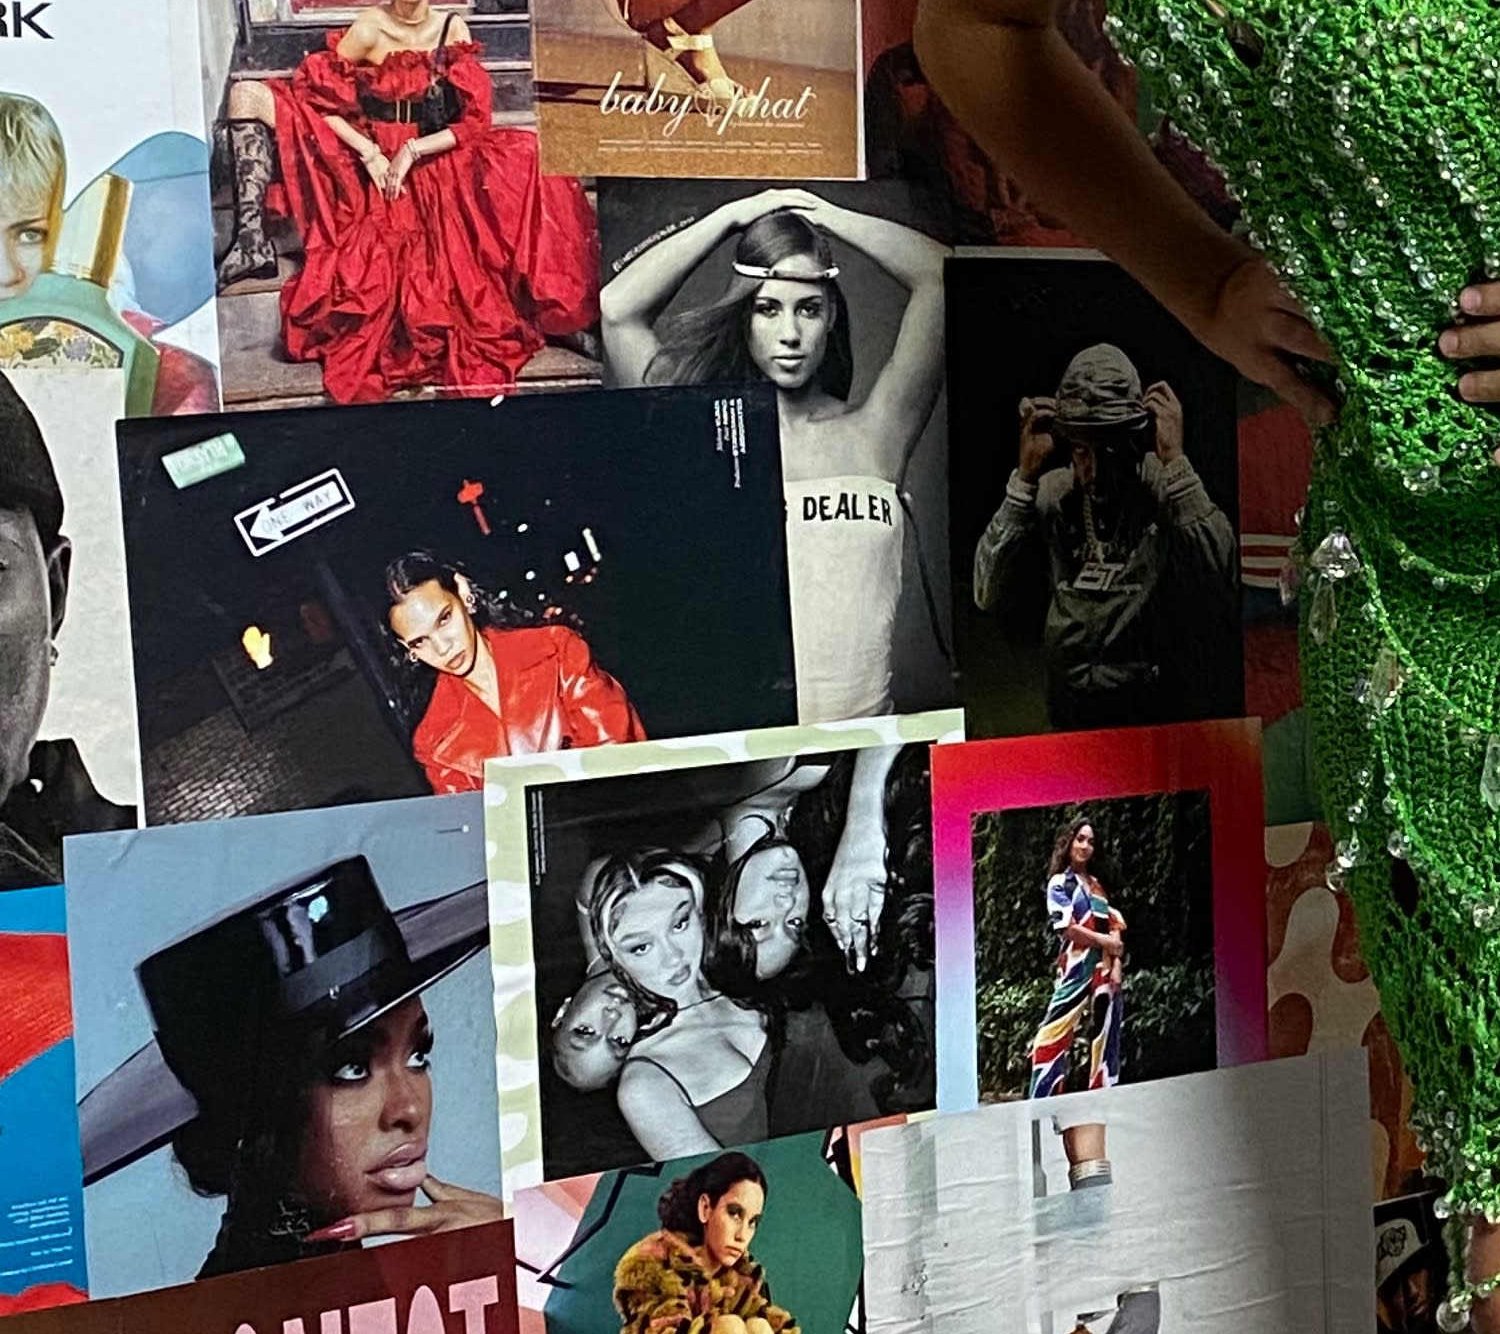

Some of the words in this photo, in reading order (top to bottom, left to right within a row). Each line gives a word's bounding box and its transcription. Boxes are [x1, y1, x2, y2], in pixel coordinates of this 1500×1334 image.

[599, 71, 694, 138] baby
[716, 76, 818, 136] phat
[260, 509, 290, 534] ONE
[302, 489, 332, 513] WAY
[802, 492, 893, 526] DEALER
